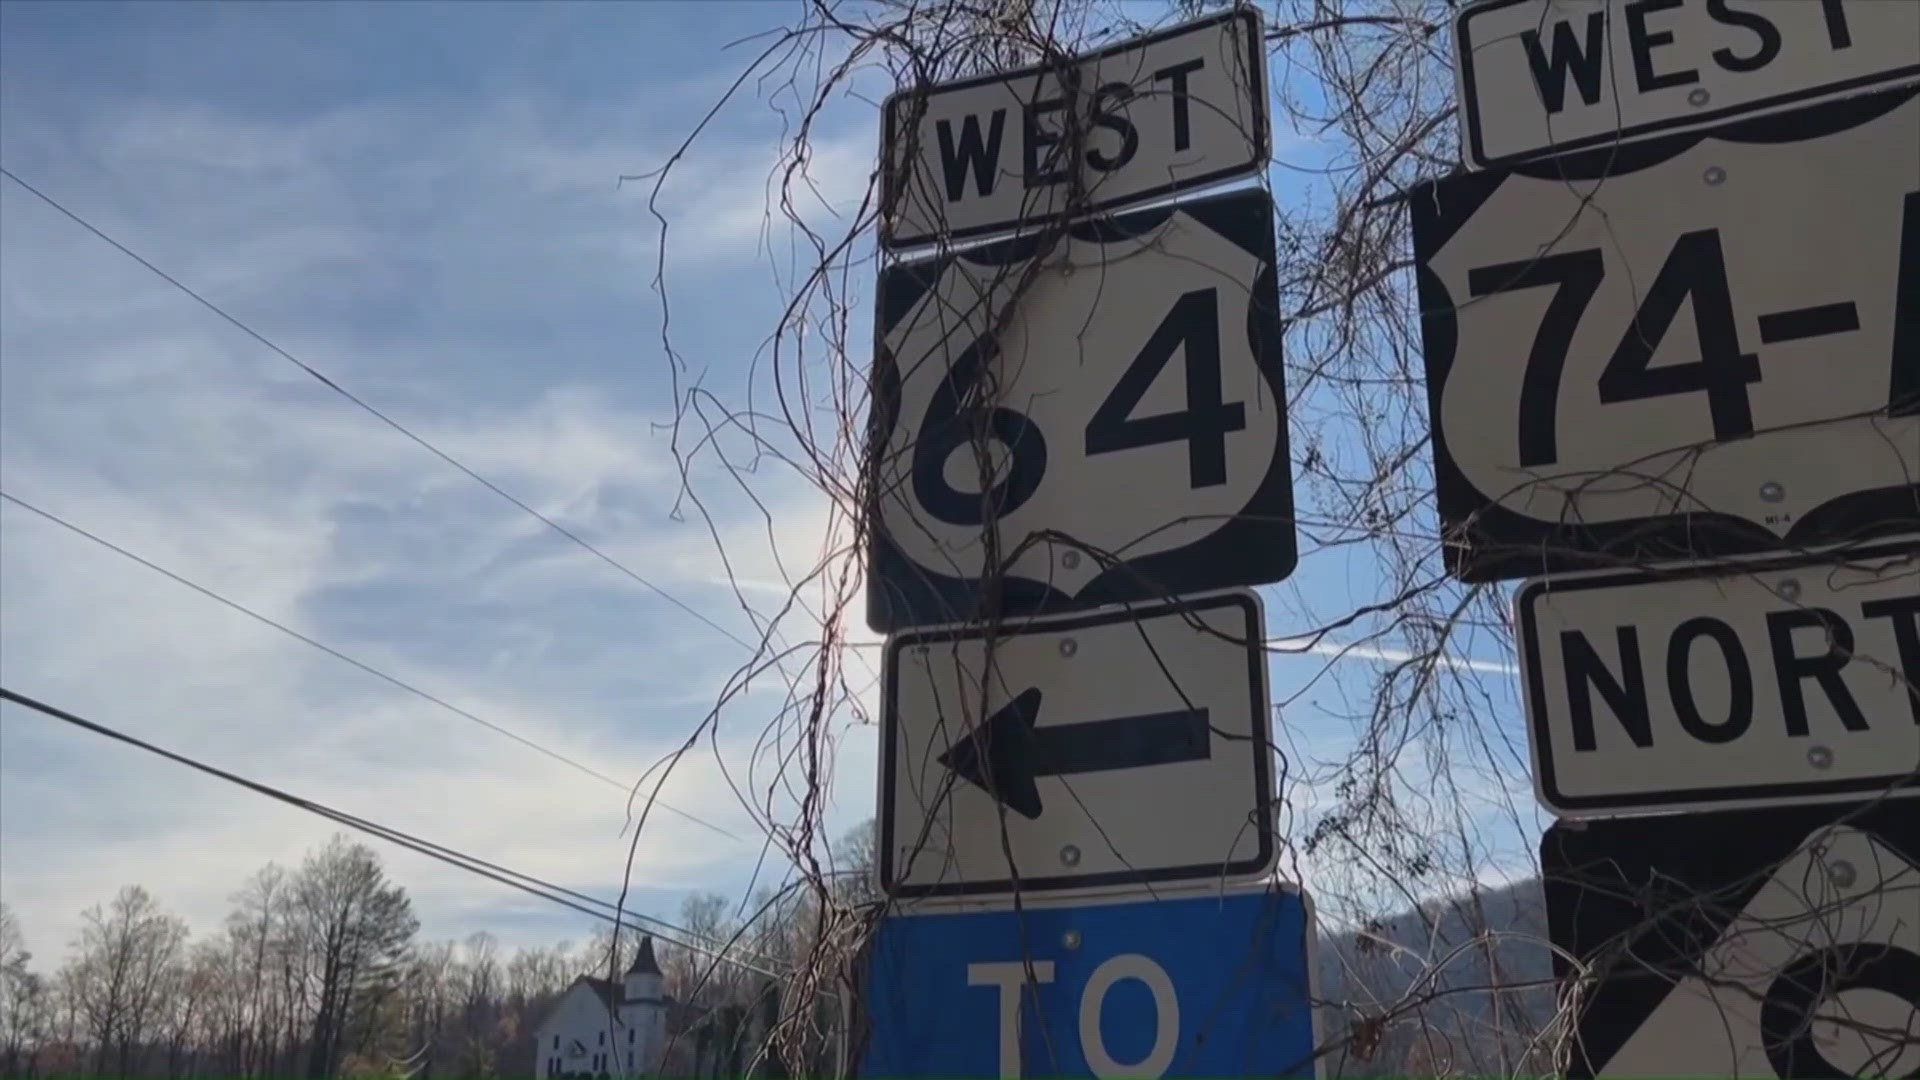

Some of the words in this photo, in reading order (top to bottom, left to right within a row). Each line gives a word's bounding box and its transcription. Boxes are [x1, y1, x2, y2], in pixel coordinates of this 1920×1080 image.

[936, 57, 1204, 202] WEST
[912, 286, 1246, 526] 64
[968, 953, 1180, 1080] TO
